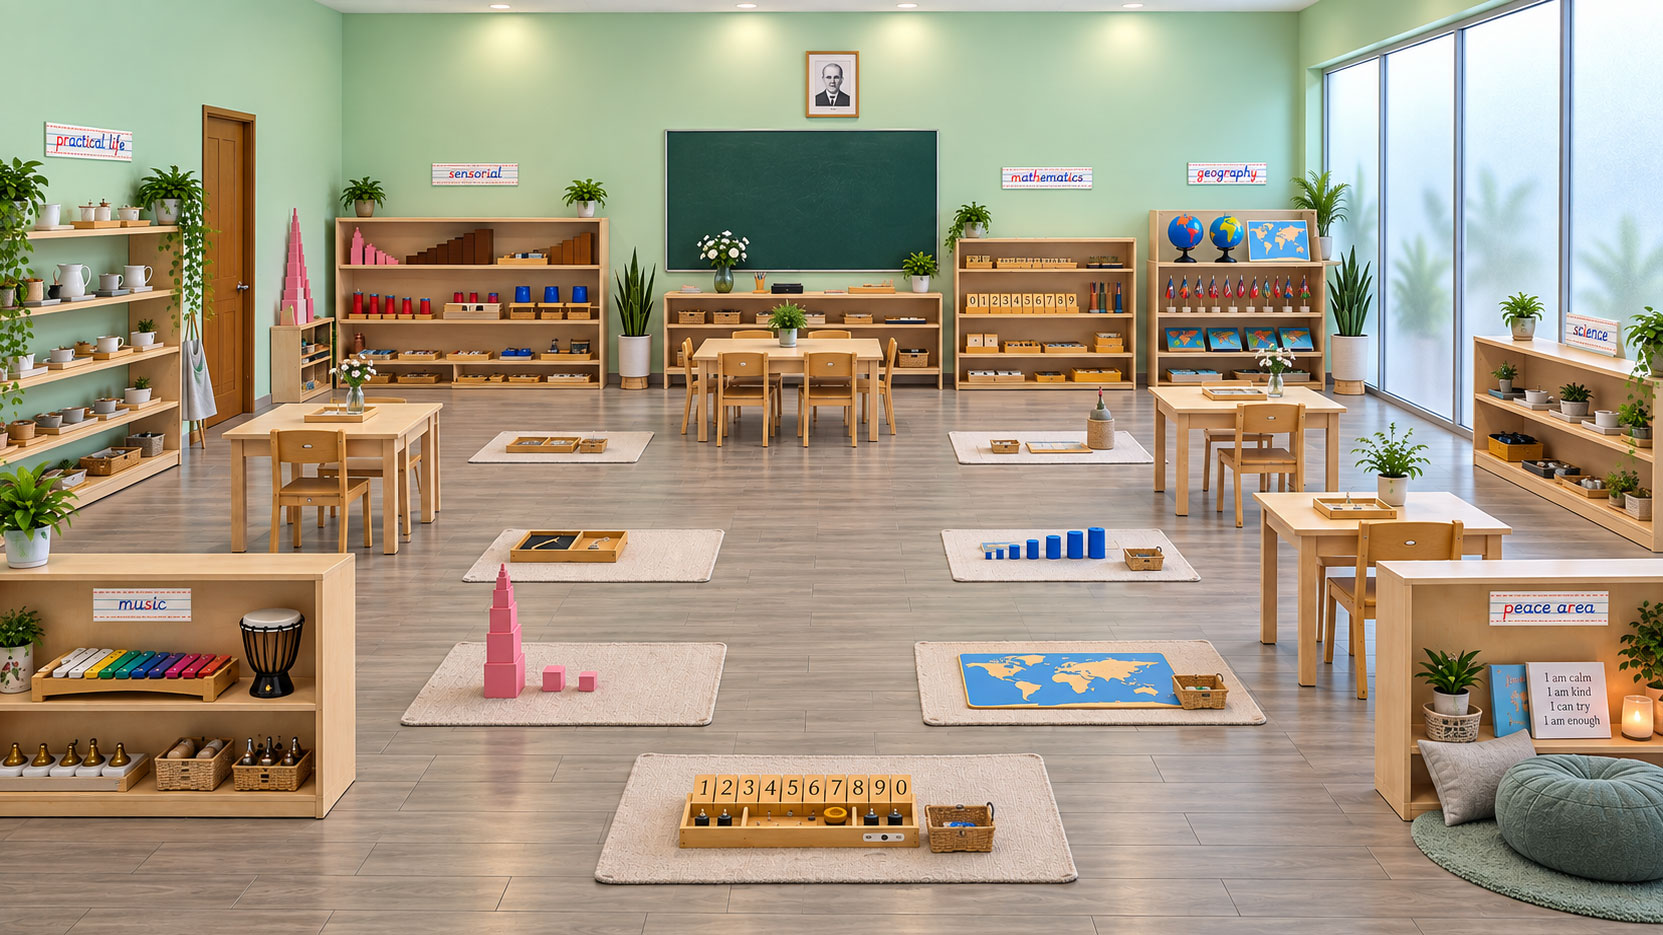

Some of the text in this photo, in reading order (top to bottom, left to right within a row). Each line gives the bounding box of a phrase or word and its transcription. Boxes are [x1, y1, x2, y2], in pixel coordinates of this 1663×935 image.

[56, 133, 125, 156] practical life
[448, 166, 503, 179] sensorial
[1011, 169, 1083, 182] mathematics
[1197, 165, 1257, 183] geography
[969, 296, 1075, 305] 0 1 2 3 4 5 6 7 8 9
[1572, 323, 1608, 342] science
[118, 596, 167, 611] music
[1503, 603, 1595, 621] peace area
[1544, 672, 1592, 683] I am calm
[1547, 686, 1592, 697] I am kind
[1550, 701, 1590, 714] I can try
[1544, 715, 1601, 729] I am enough
[700, 779, 907, 796] 1 2 3 4 5 6 7 8 9 0
